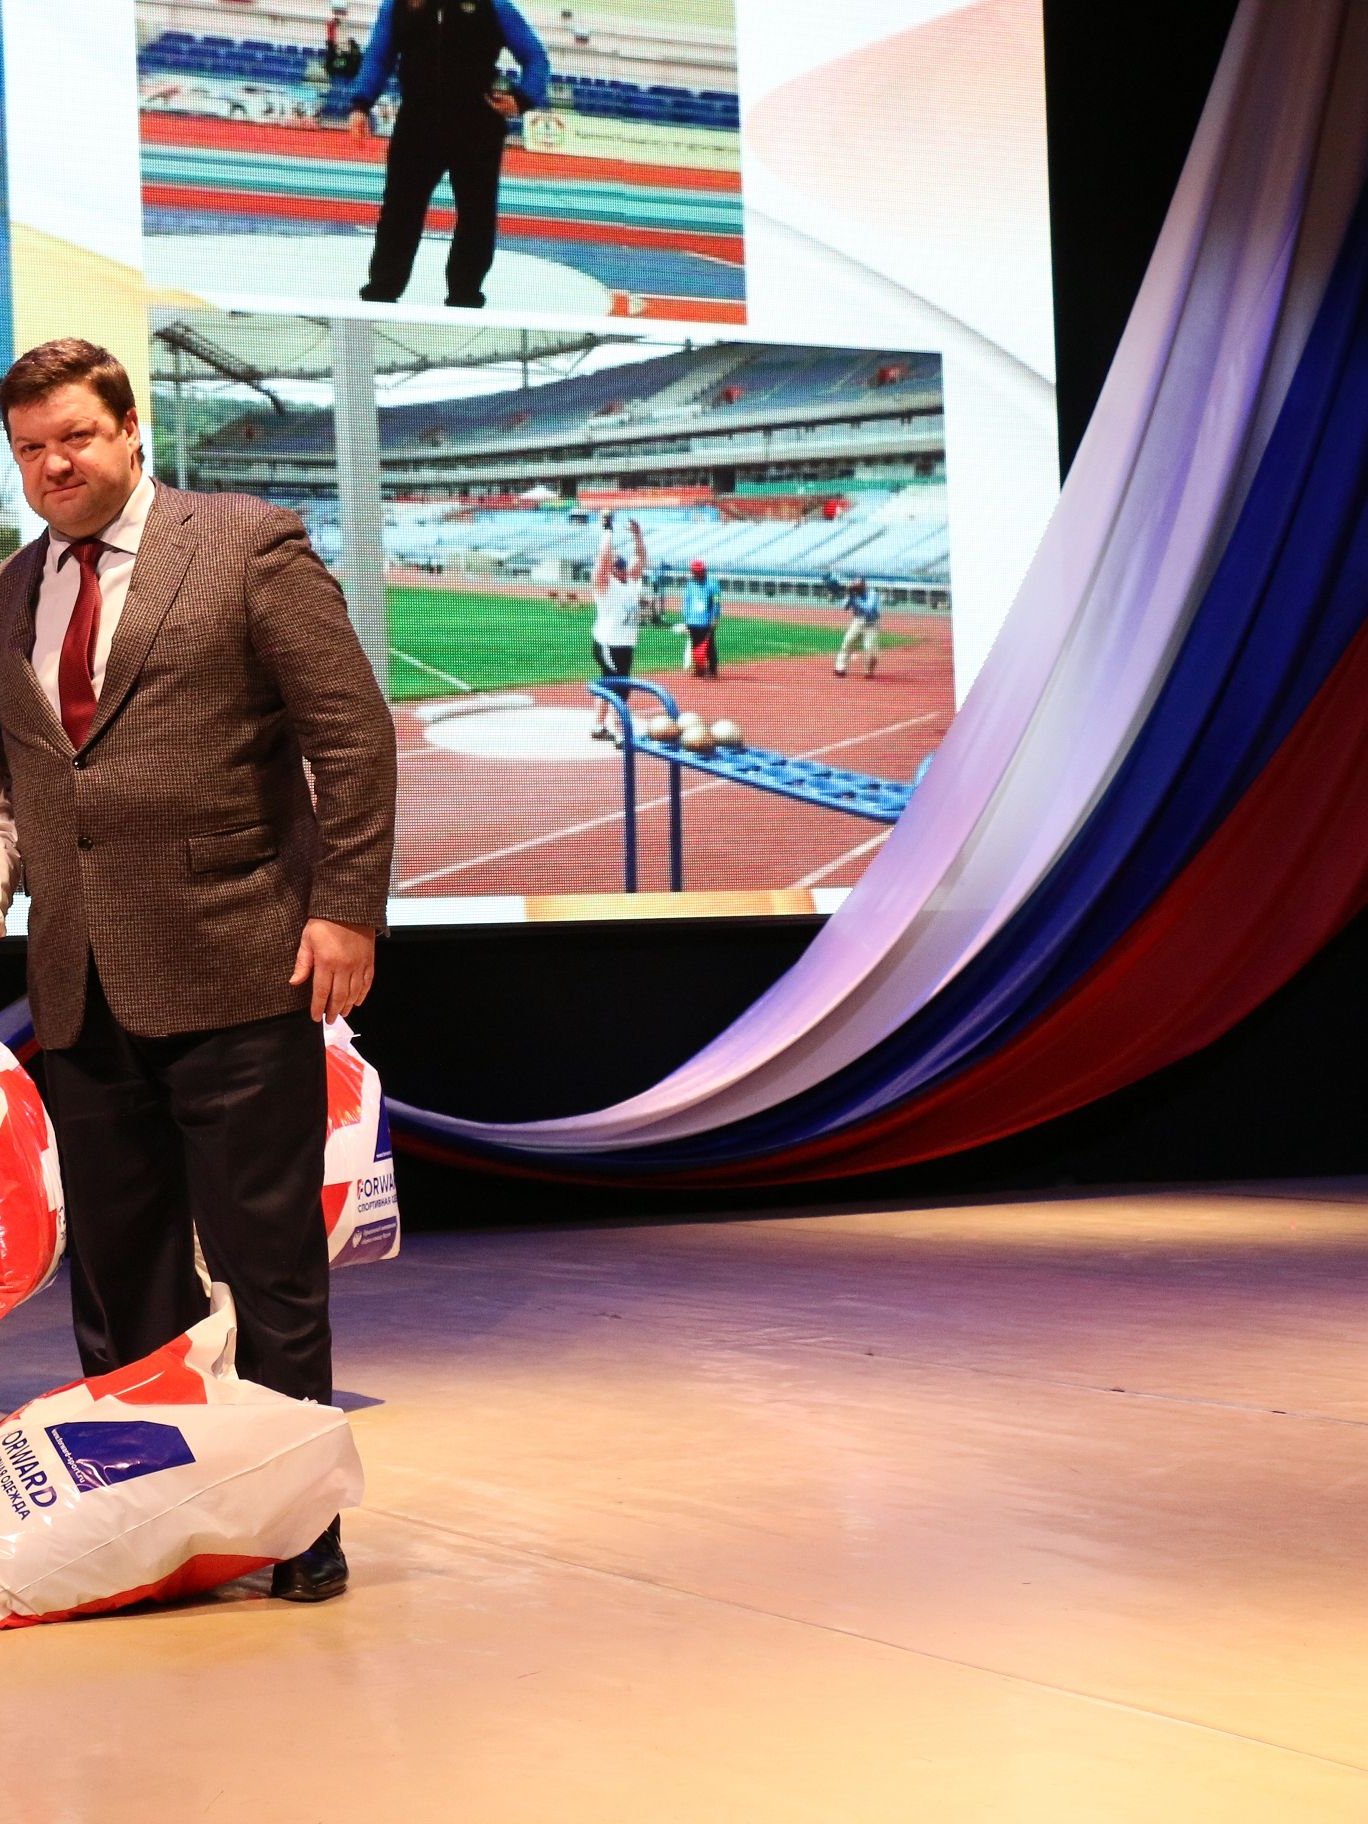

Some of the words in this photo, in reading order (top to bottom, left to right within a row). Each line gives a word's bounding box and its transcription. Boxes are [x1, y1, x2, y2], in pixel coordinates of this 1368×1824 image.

[357, 1173, 396, 1200] FORWA
[3, 1429, 58, 1508] ORWARD
[0, 1475, 31, 1521] ОДЕЖДА
